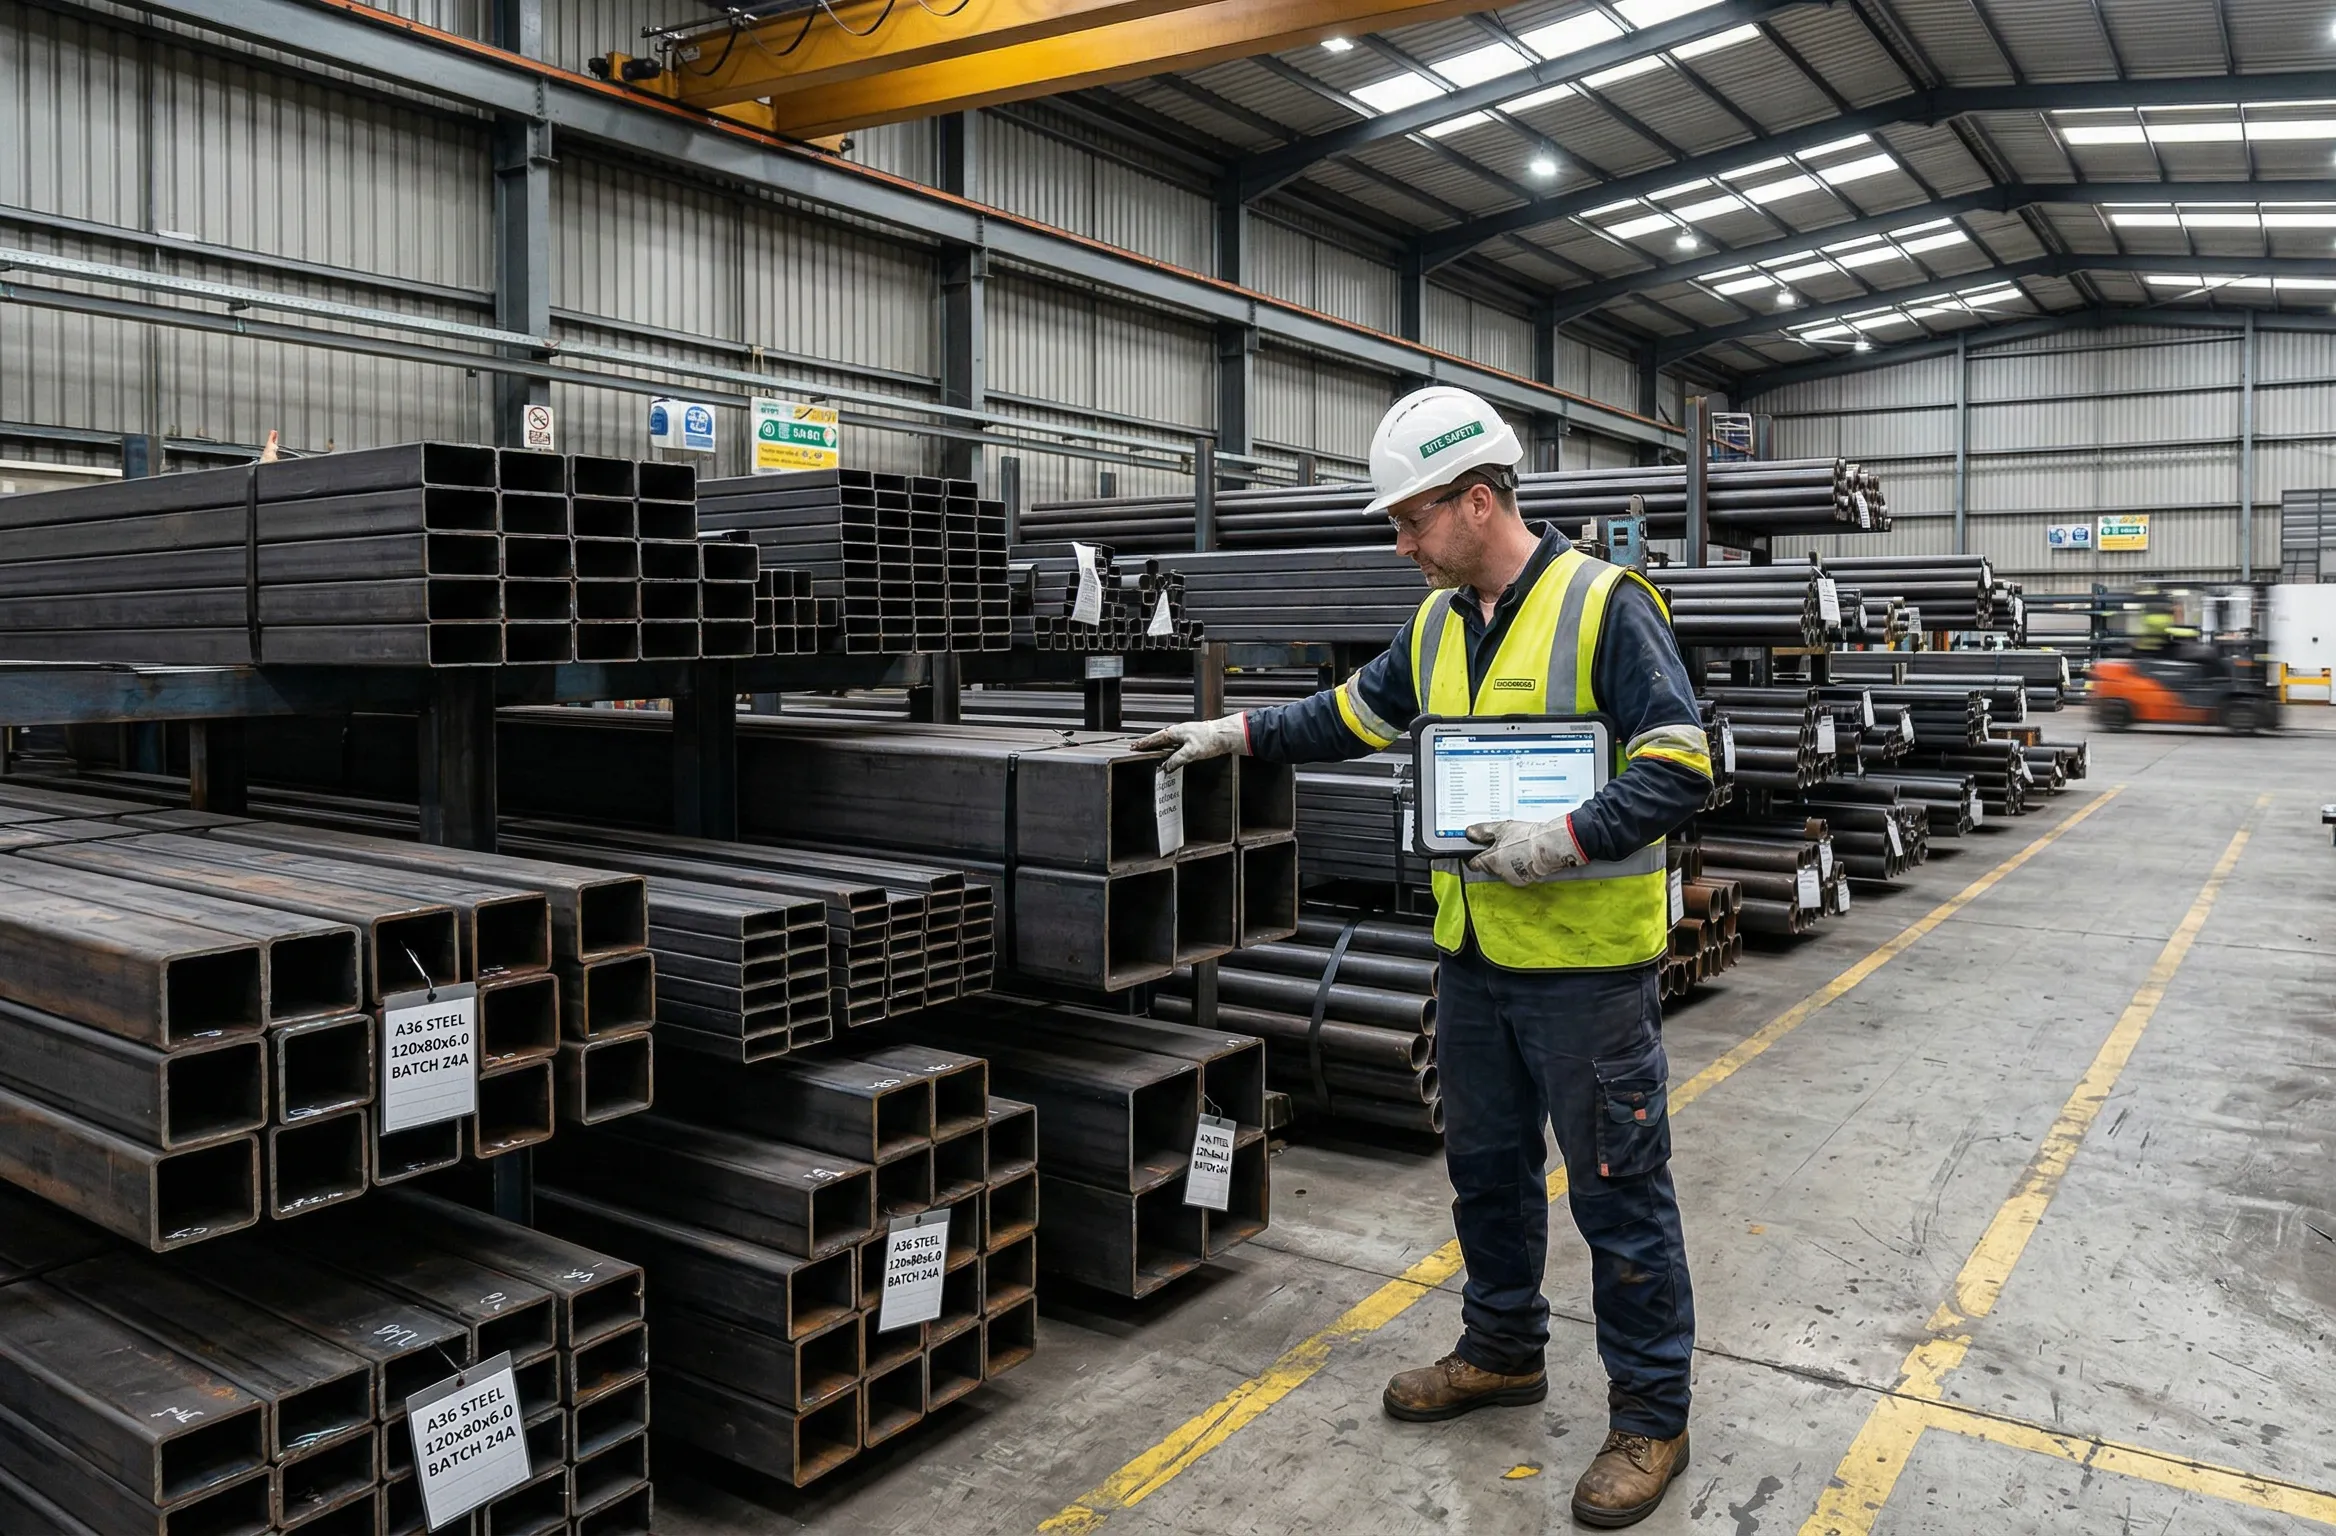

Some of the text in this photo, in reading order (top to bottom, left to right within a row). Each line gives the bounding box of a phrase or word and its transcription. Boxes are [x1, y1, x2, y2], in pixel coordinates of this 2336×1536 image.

[1444, 424, 1475, 444] SAFETY
[395, 1013, 465, 1037] A36 STEEL
[391, 1032, 469, 1059] 120x80x6.0
[392, 1058, 439, 1079] BATCH
[893, 1235, 940, 1253] A36 STEEL
[887, 1267, 939, 1287] BATCH 24A
[426, 1387, 505, 1434] A36 STEEL
[425, 1404, 513, 1456] 120x80x6.0
[428, 1425, 517, 1477] BATCH 24A
